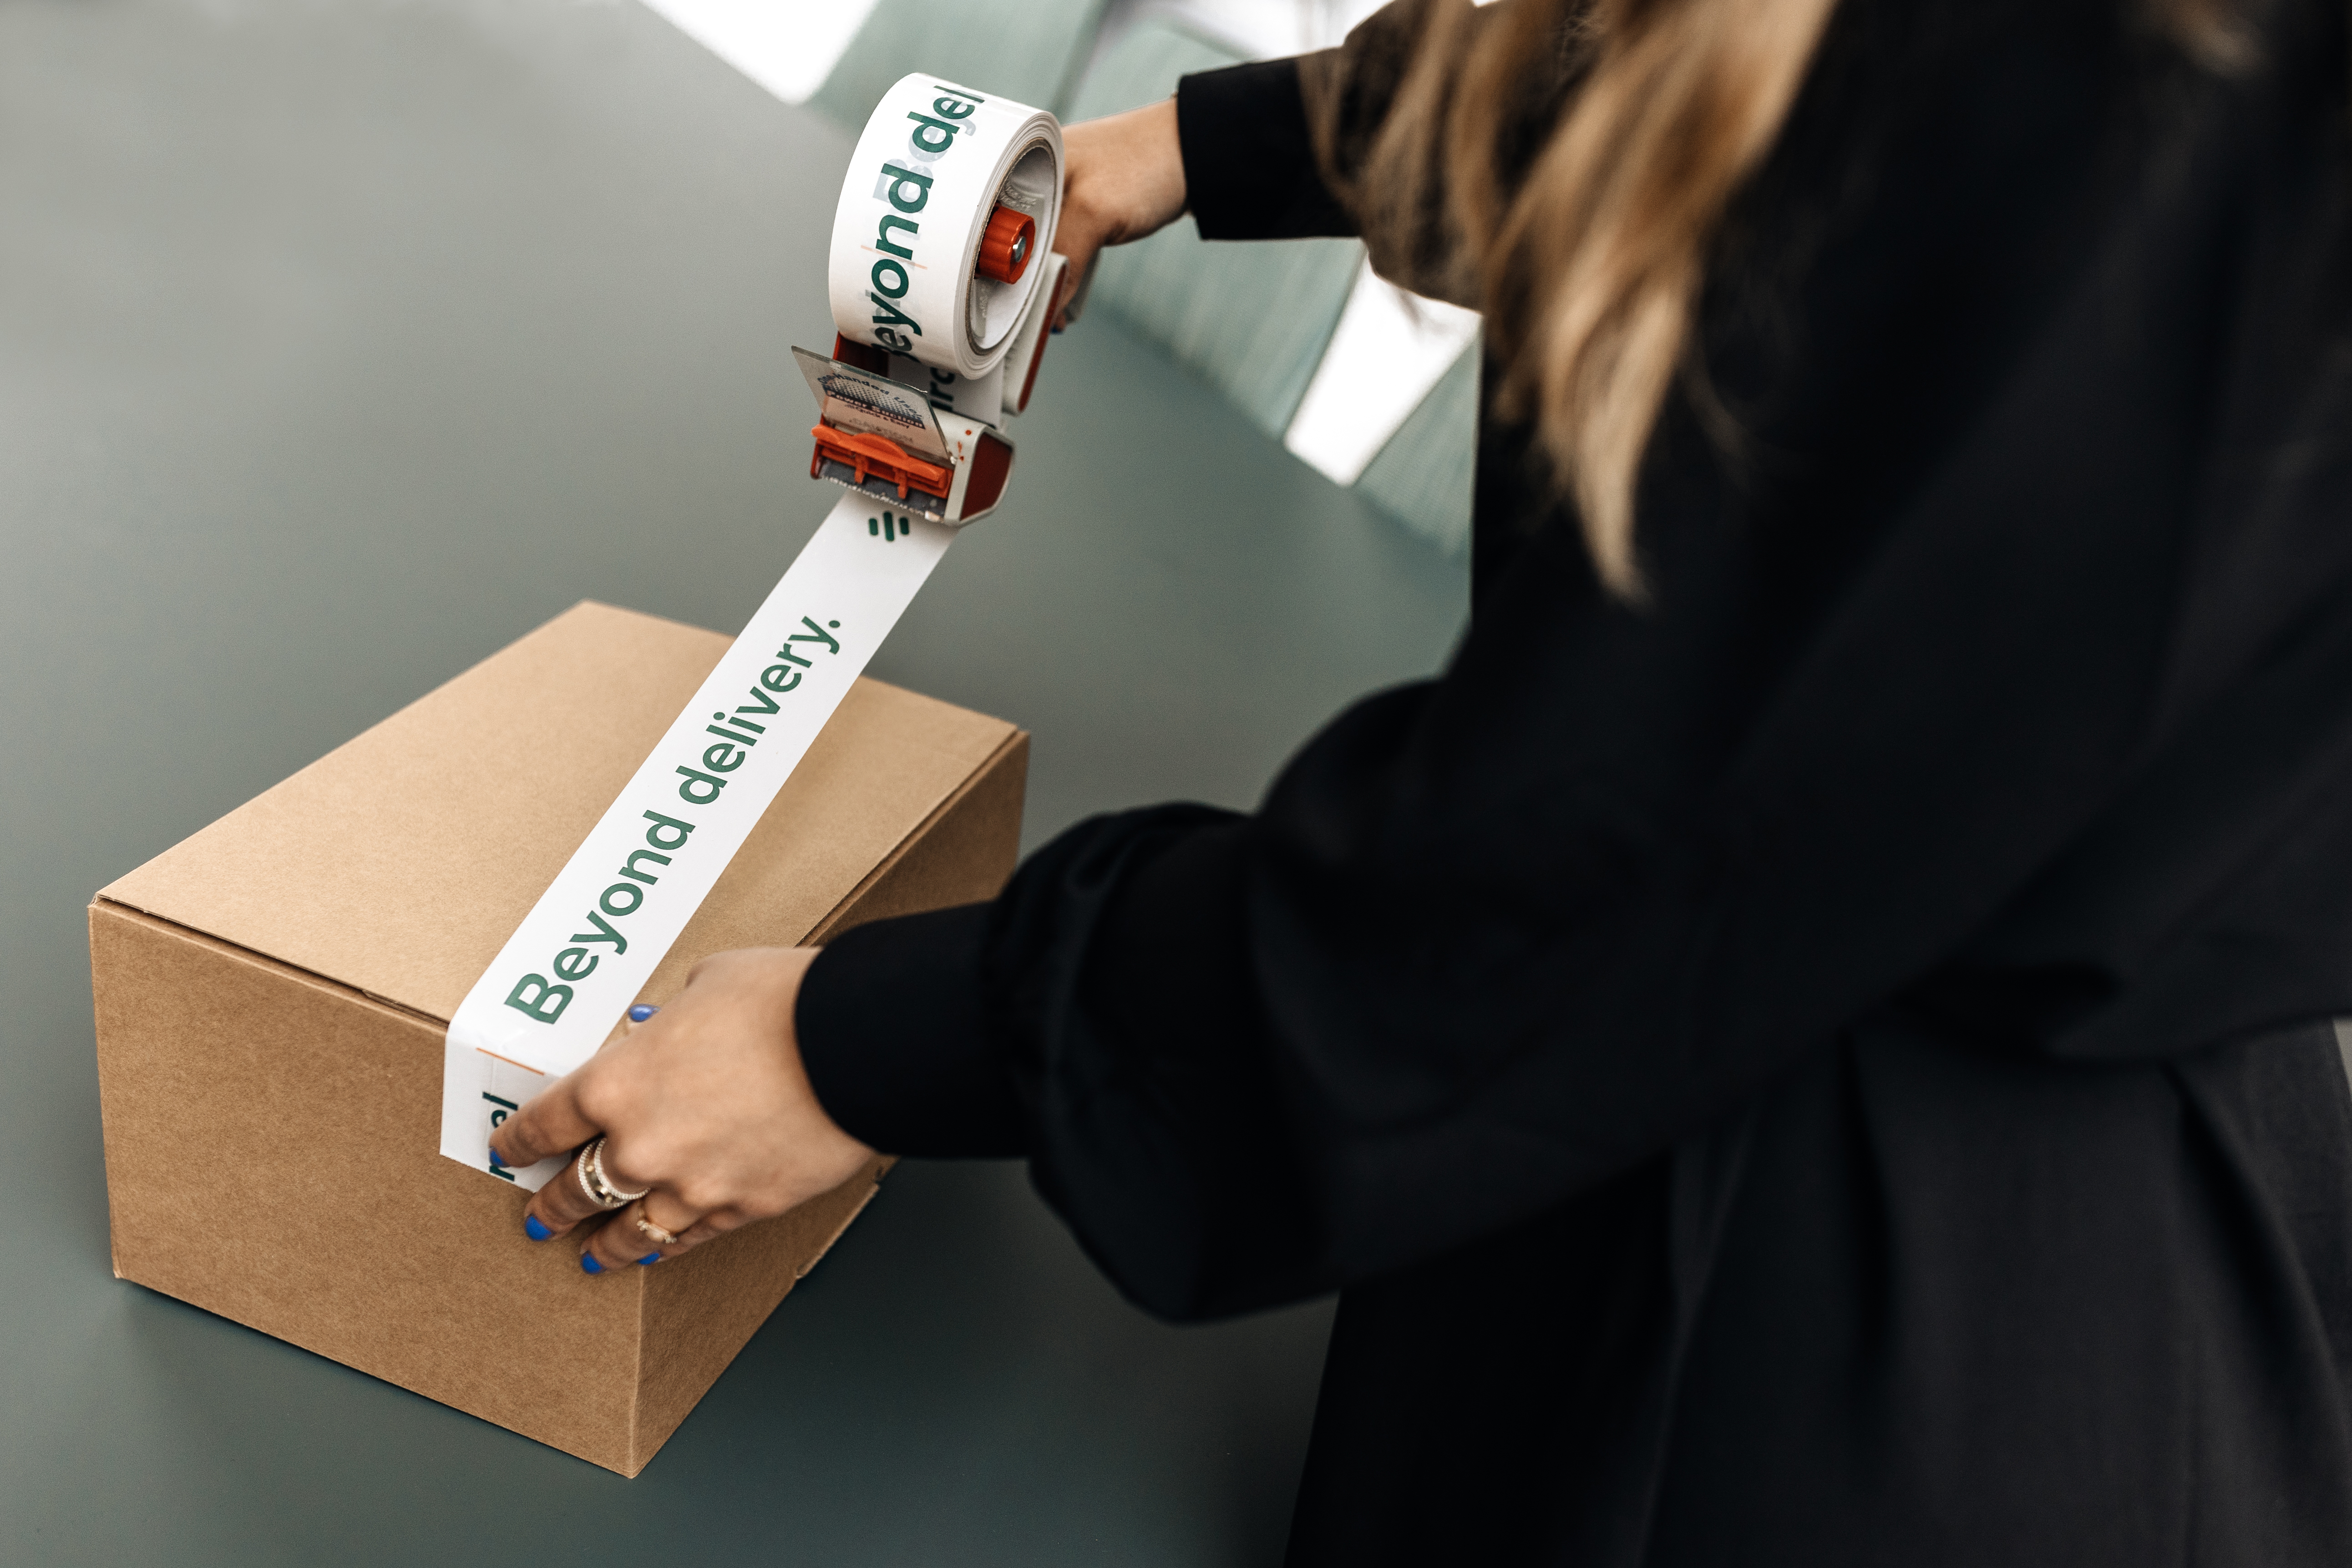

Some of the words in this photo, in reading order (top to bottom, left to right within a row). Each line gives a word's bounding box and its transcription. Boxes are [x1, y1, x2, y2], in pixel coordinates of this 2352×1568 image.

[871, 163, 934, 362] eyond
[504, 809, 696, 1025] Beyond
[675, 615, 841, 805] delivery.
